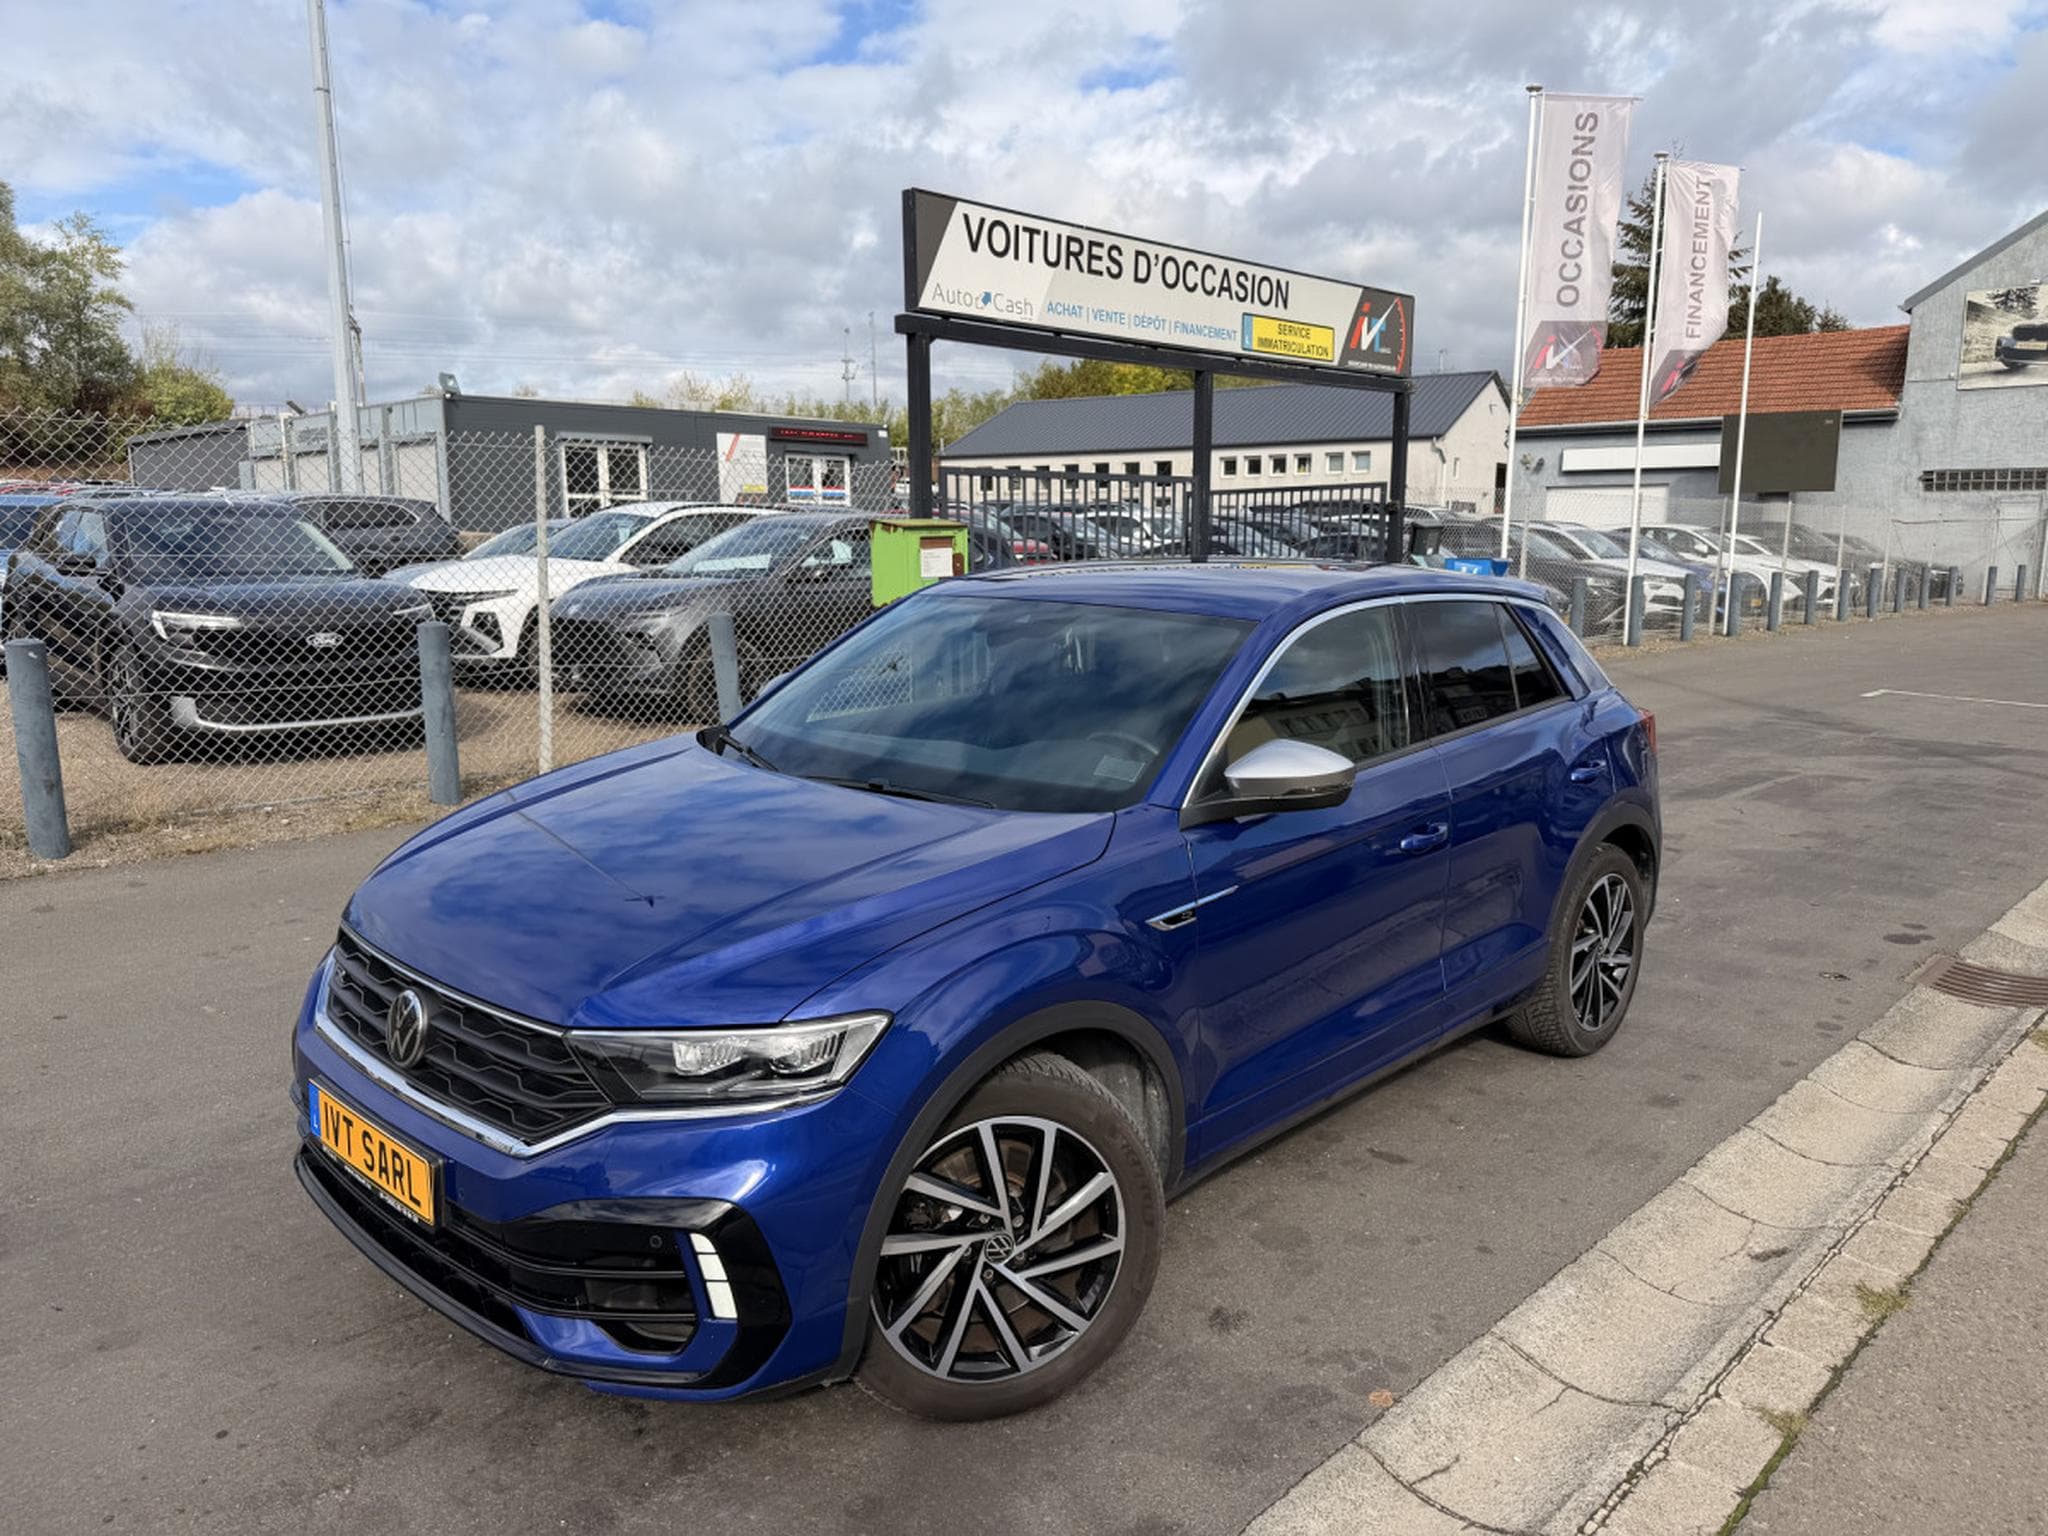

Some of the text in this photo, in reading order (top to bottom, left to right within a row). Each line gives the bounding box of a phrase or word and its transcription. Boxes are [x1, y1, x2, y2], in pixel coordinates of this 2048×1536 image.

[1556, 111, 1599, 307] OCCASIONS
[1685, 175, 1712, 339] FINANCEMENT
[962, 212, 1290, 310] VOITURES D'OCCASION
[1047, 301, 1083, 319] ACHAT
[1092, 308, 1126, 325] VENTE
[1173, 320, 1238, 342] FINANCEMENT
[1257, 337, 1329, 357] IMMATRICULATION
[1277, 323, 1311, 340] SERVICE
[324, 1102, 353, 1157] IVT
[362, 1130, 422, 1208] SARL
